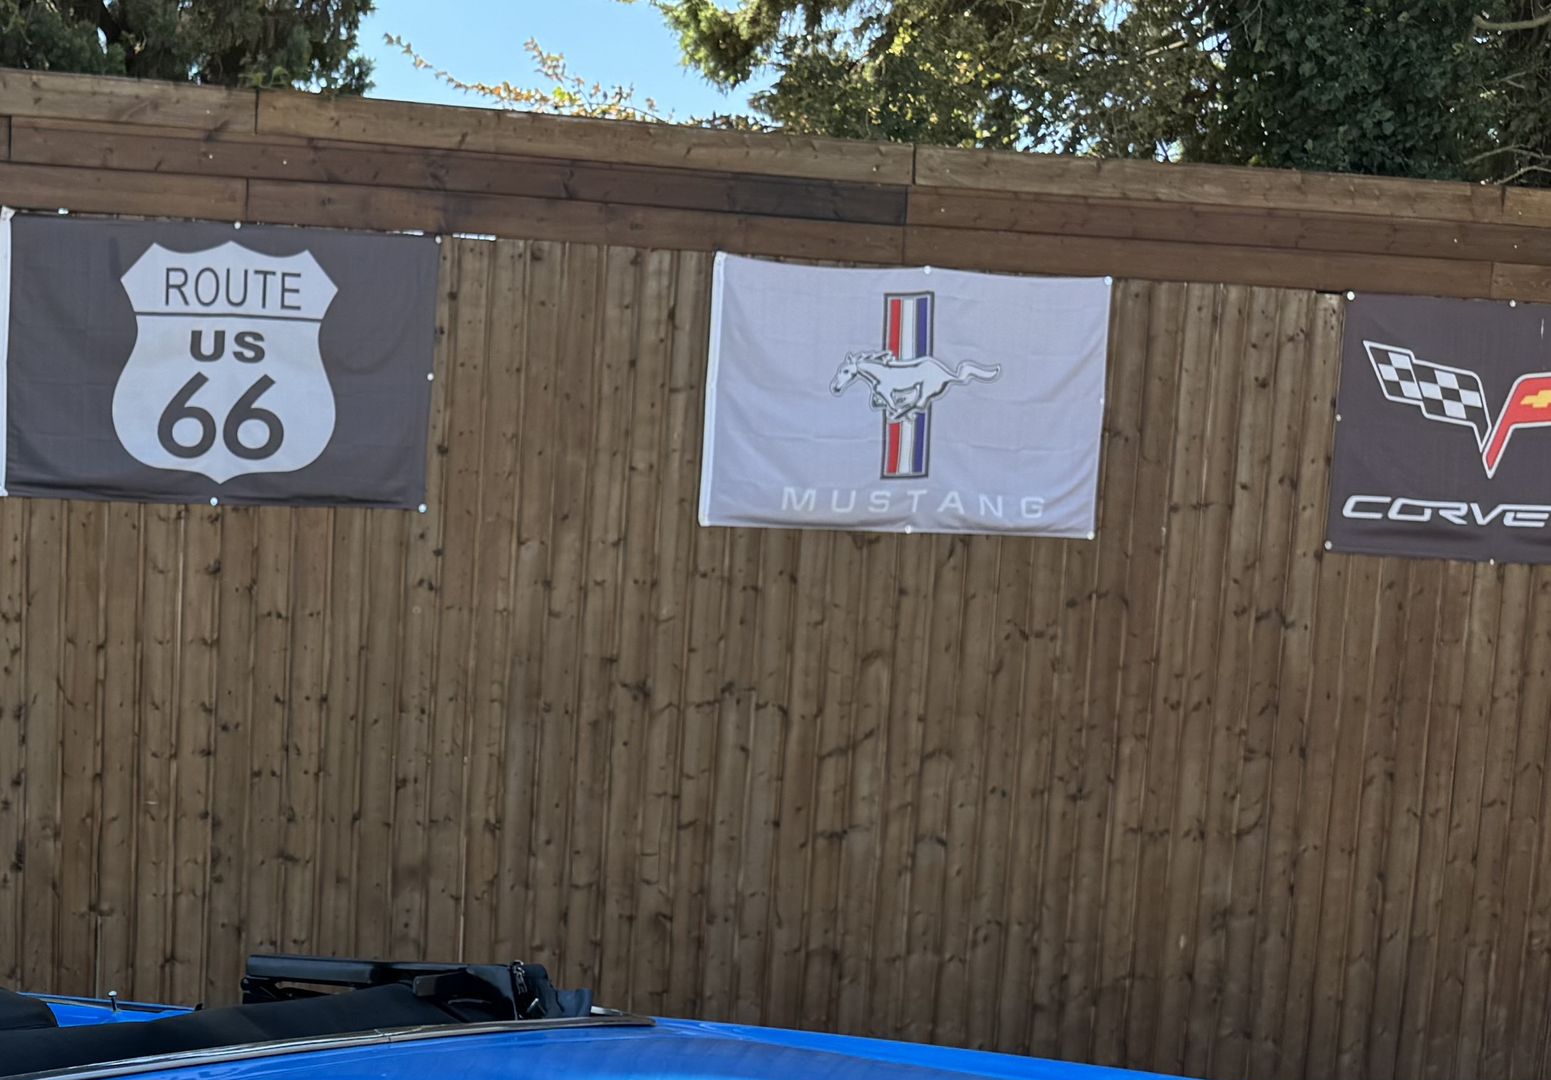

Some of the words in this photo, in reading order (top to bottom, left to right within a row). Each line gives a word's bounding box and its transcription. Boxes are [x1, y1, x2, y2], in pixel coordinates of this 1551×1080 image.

[164, 266, 302, 311] ROUTE
[189, 329, 266, 364] US
[156, 371, 285, 461] 66
[780, 486, 1046, 519] MUSTANG
[1342, 494, 1551, 529] CORVE
